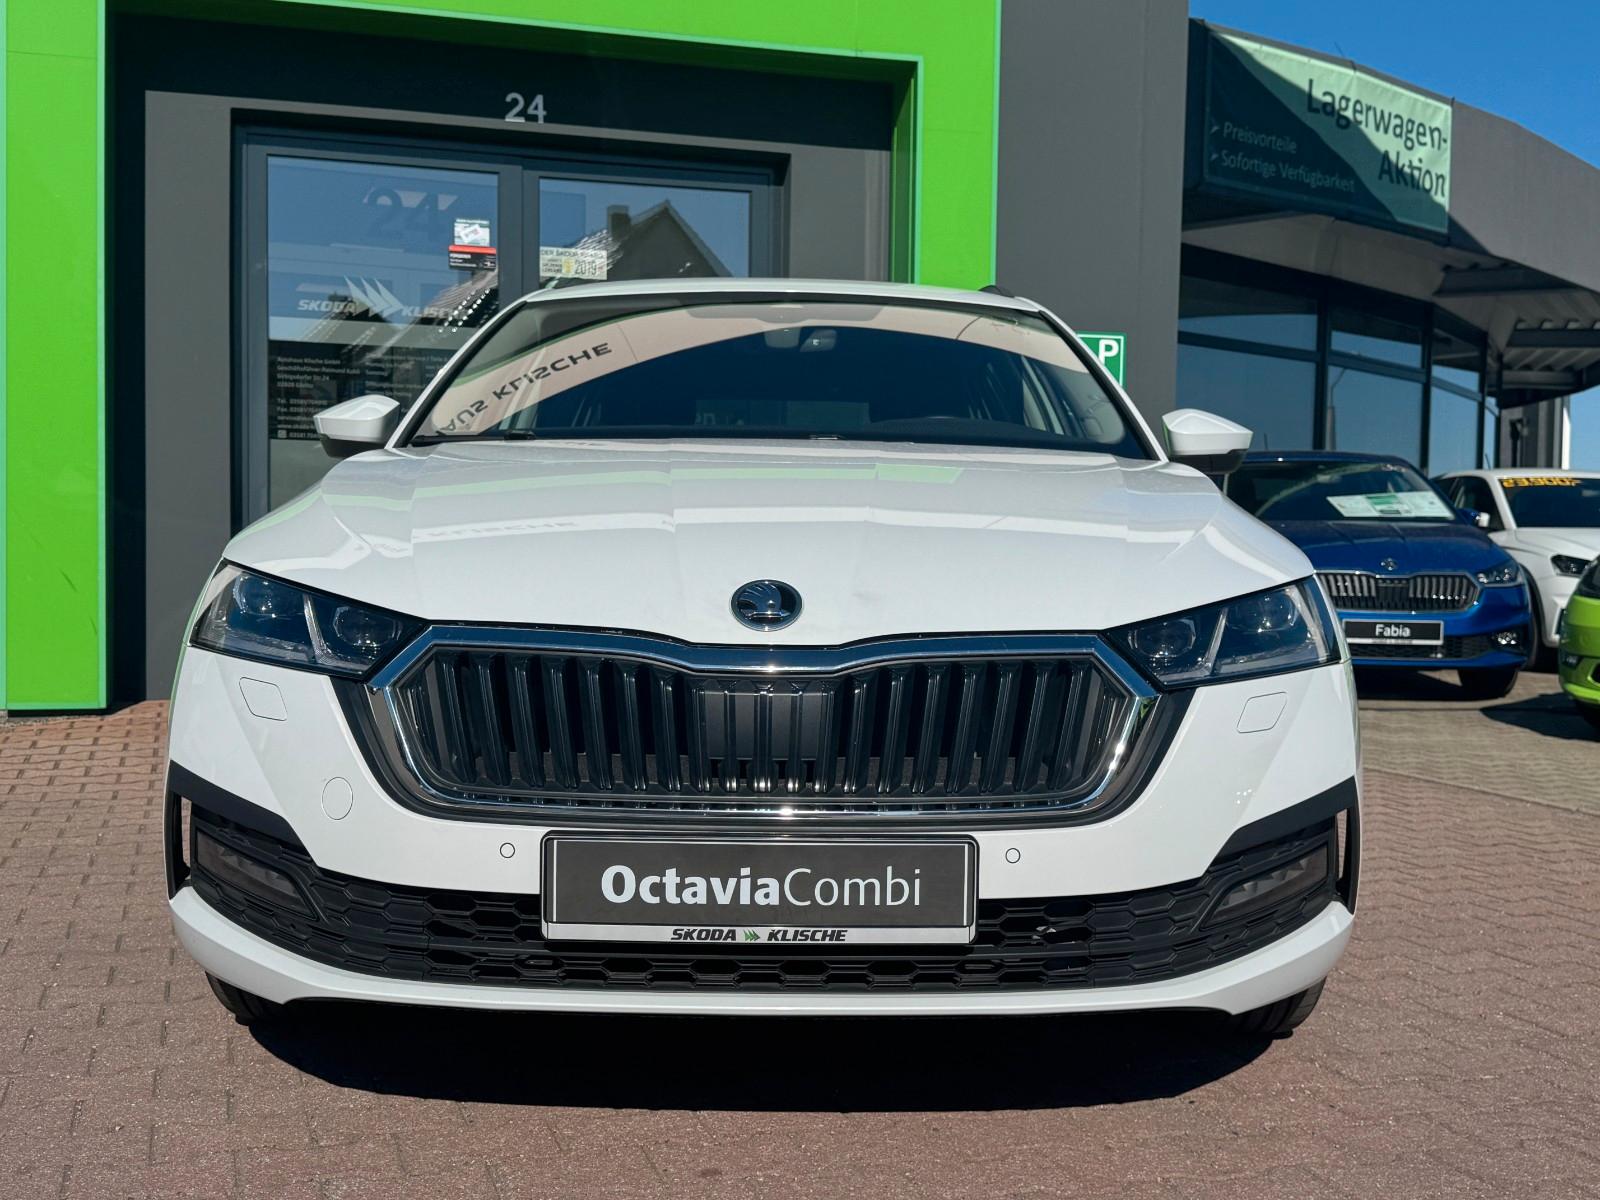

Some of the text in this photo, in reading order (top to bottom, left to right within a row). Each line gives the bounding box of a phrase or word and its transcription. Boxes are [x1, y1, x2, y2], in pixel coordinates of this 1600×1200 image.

[505, 92, 547, 124] 24
[1307, 78, 1448, 150] Lagerwagen-
[1223, 122, 1297, 154] Preisvorteile
[1221, 150, 1355, 192] Sofortige Verfügbarkeit
[1378, 150, 1446, 197] Aktion
[1099, 339, 1119, 366] P
[1375, 624, 1411, 637] Fabia
[767, 929, 848, 942] KLISCHE
